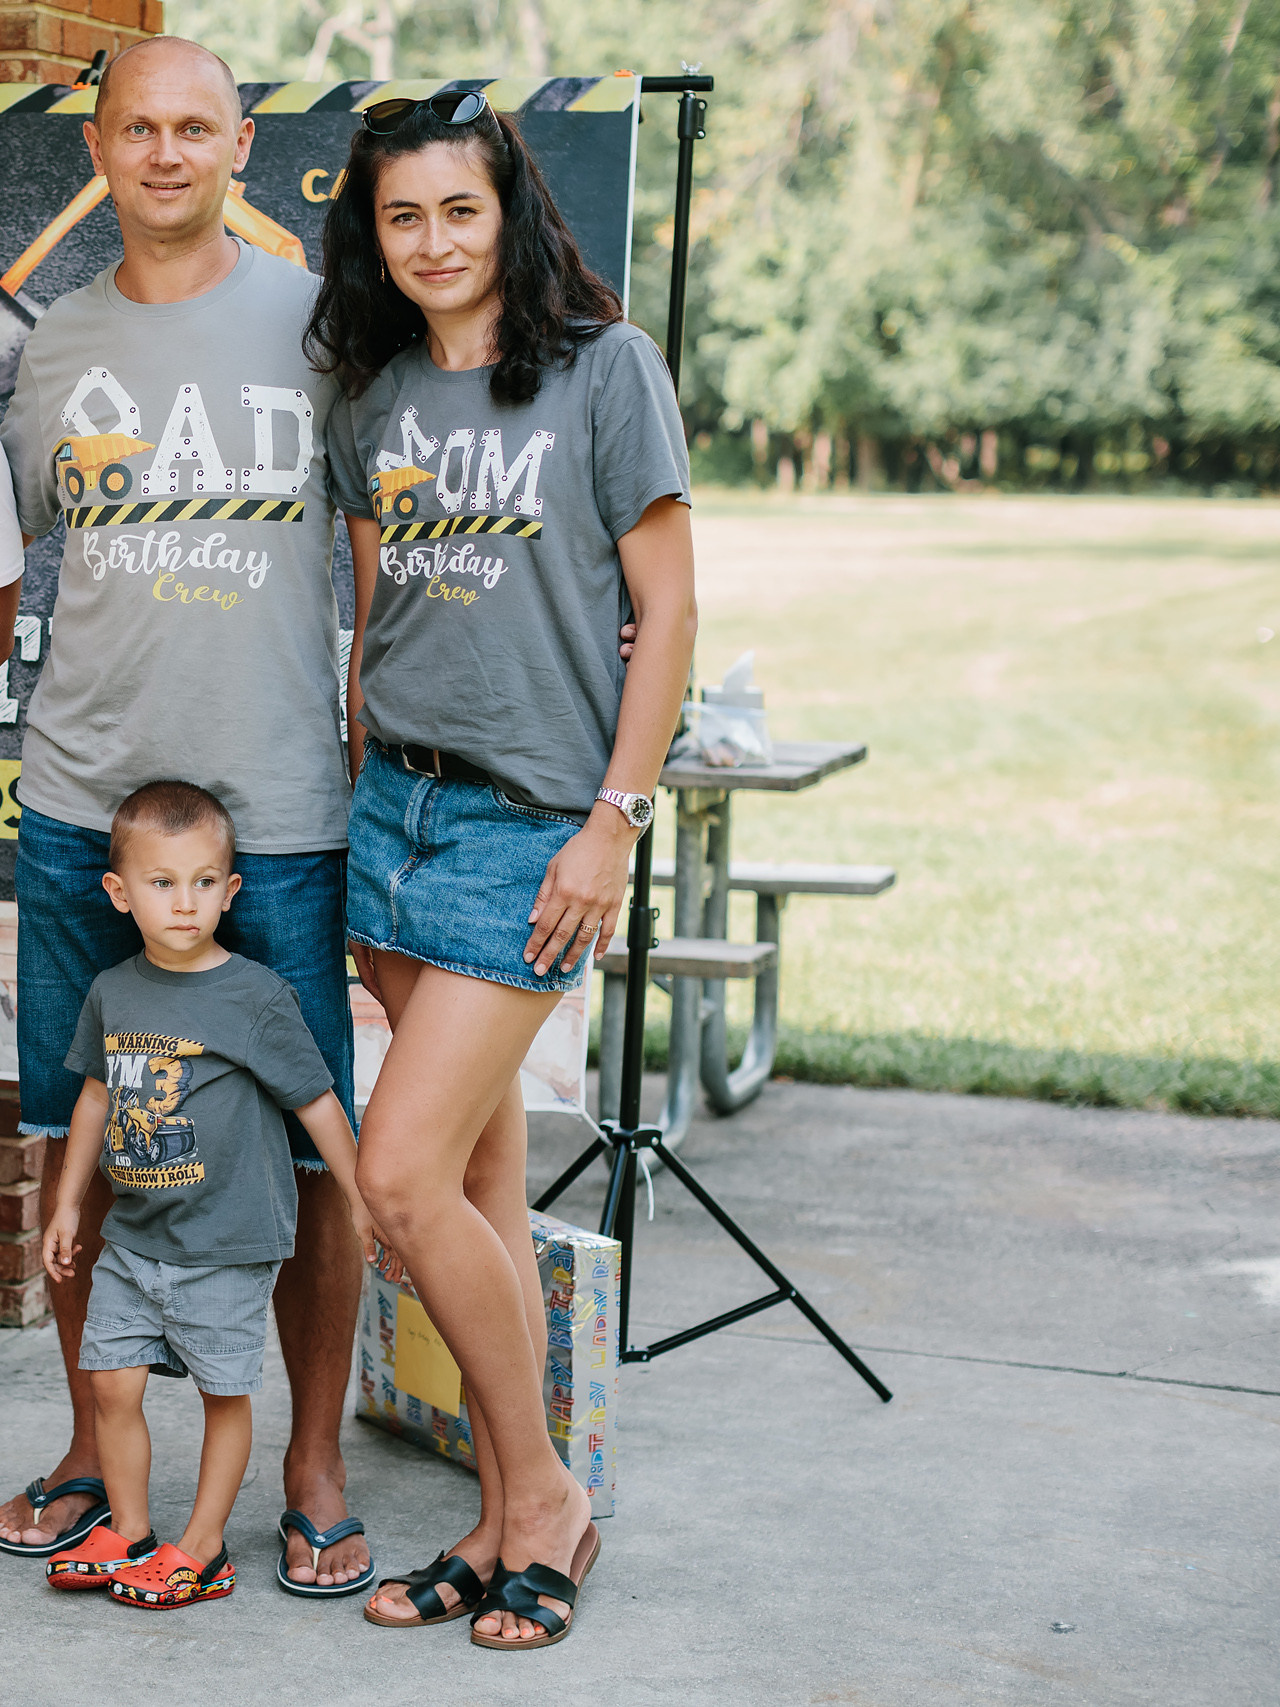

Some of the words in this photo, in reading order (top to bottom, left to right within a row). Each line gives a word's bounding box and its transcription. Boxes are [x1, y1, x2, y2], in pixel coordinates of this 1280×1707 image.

[83, 529, 273, 589] Birthday
[152, 569, 244, 610] Crew
[426, 575, 480, 606] Crew
[118, 1035, 179, 1053] WARNING
[106, 1053, 148, 1089] I'M
[145, 1055, 192, 1117] 3
[115, 1155, 132, 1167] AND
[127, 1171, 134, 1182] IS
[134, 1173, 159, 1184] HOW
[161, 1172, 167, 1183] I
[169, 1168, 199, 1182] ROLL
[547, 1355, 575, 1442] HAPPY
